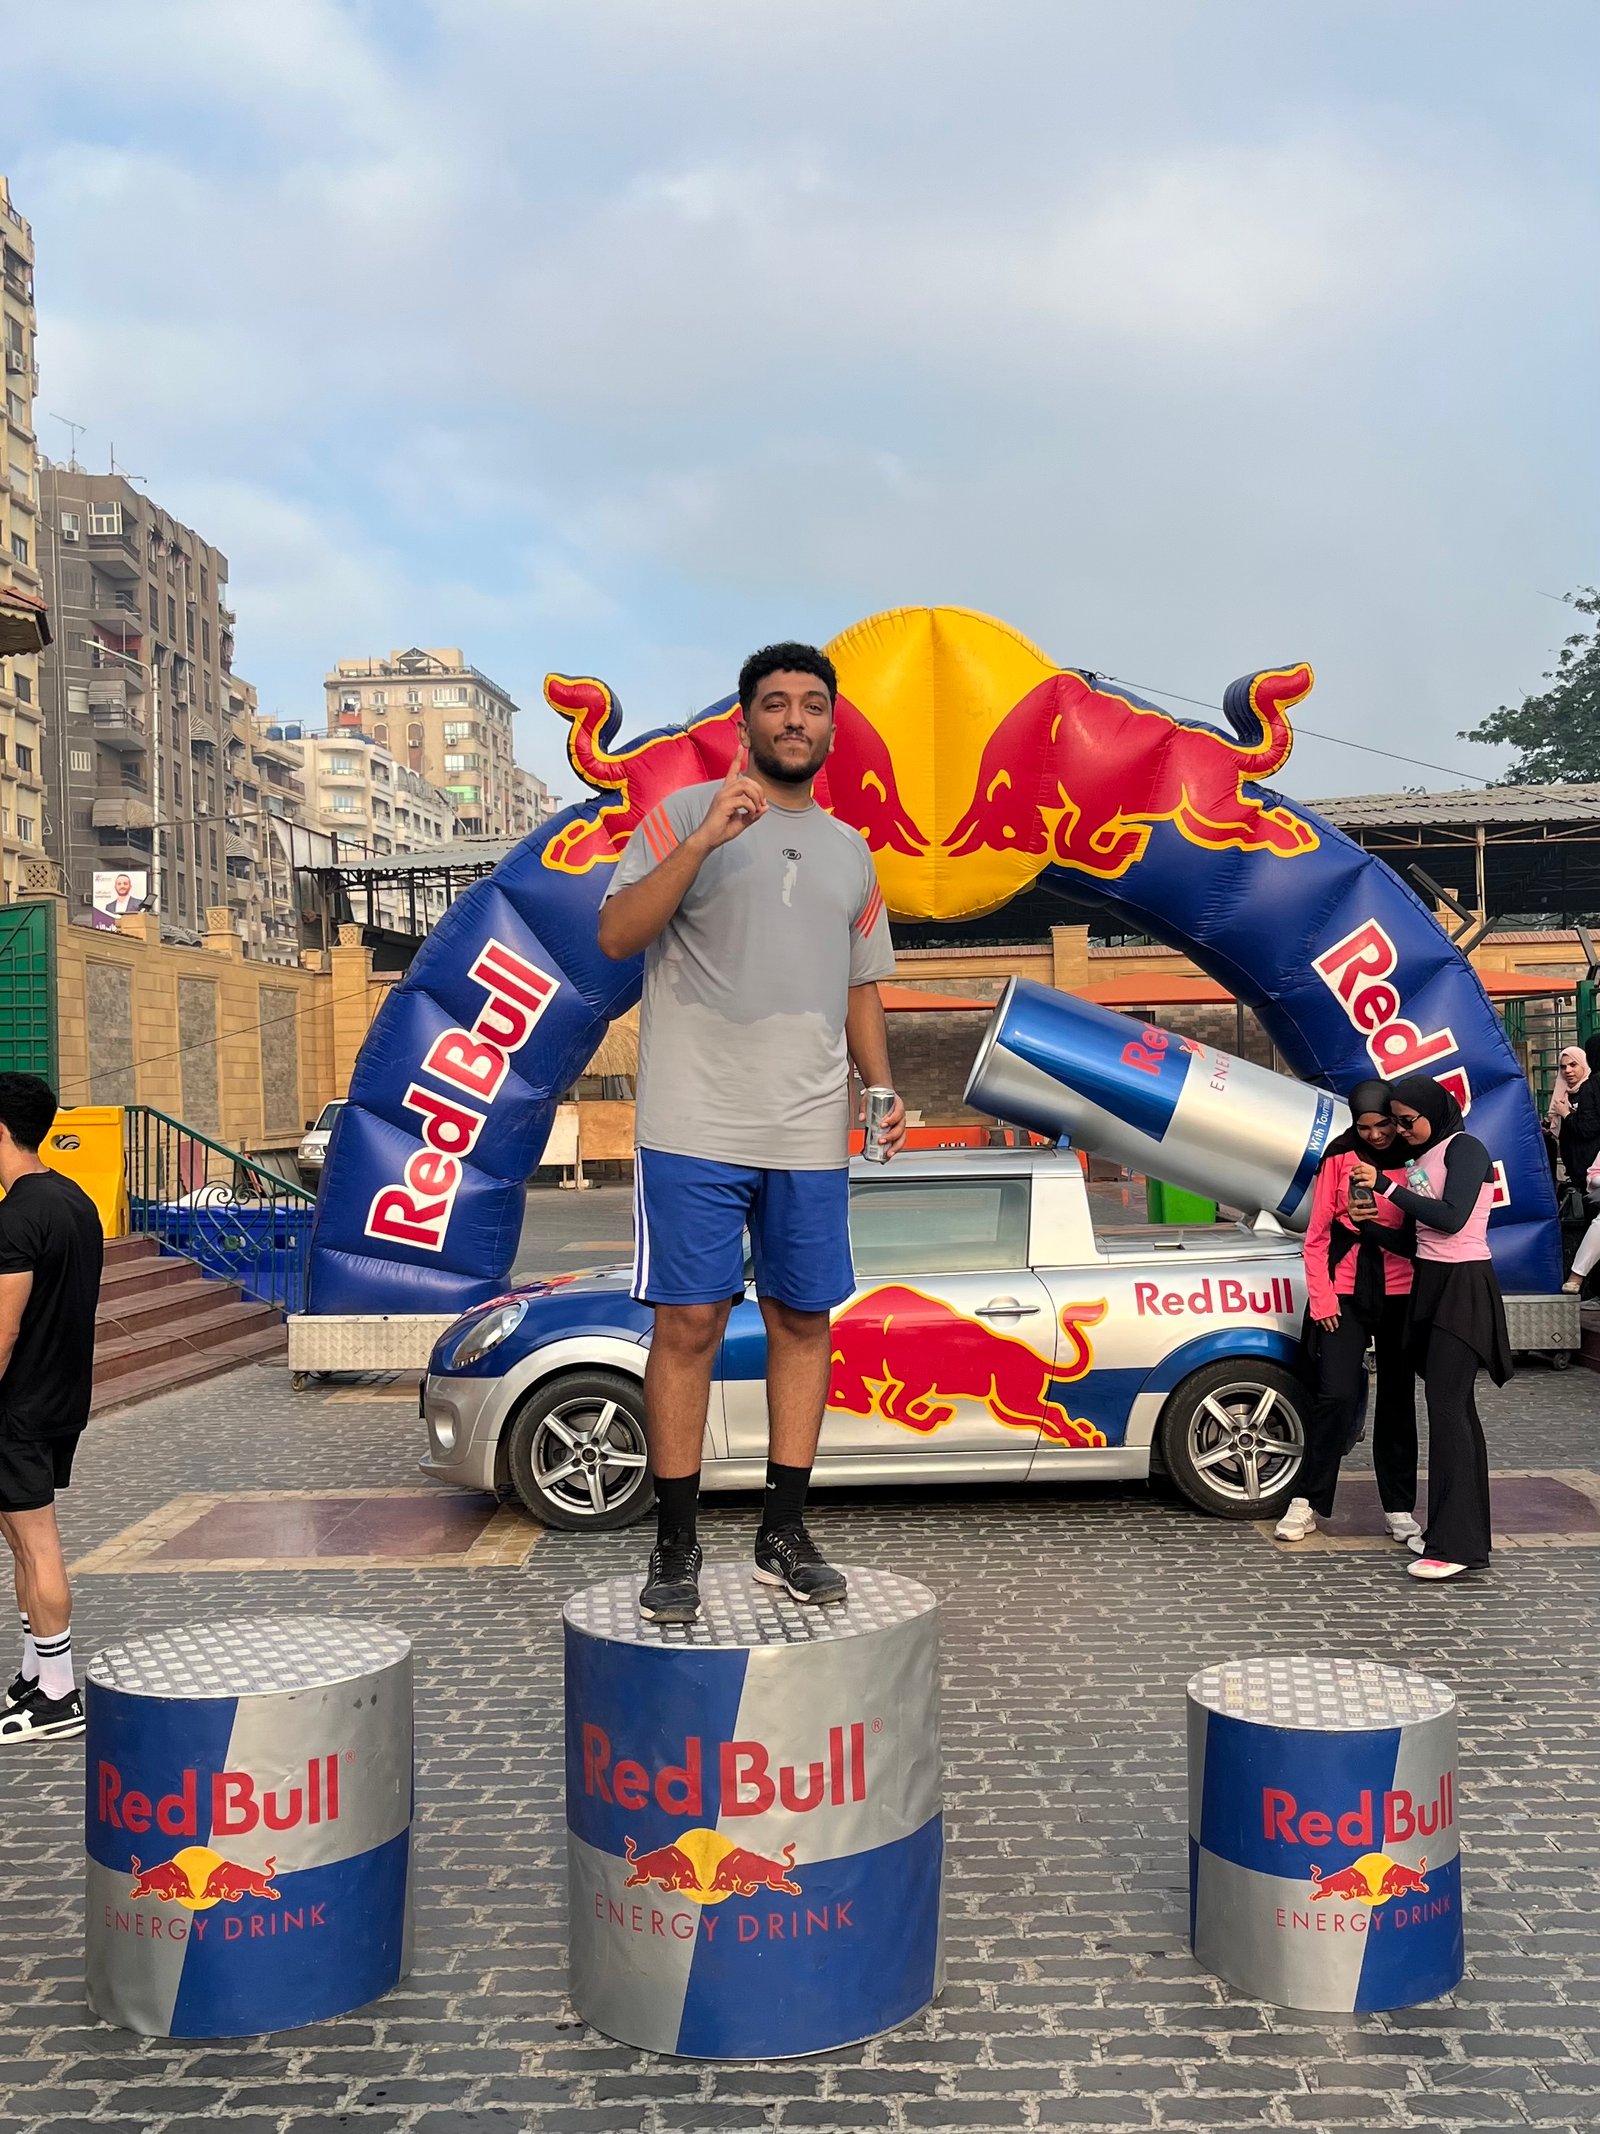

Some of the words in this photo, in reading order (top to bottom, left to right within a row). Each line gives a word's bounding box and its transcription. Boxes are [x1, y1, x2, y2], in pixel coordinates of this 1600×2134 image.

[1318, 924, 1453, 1076] Red
[369, 1089, 480, 1247] Red
[427, 944, 554, 1097] Bull
[1315, 1098, 1332, 1127] Taurine
[1307, 1123, 1325, 1151] With
[1134, 1278, 1214, 1316] Red
[1218, 1277, 1294, 1314] Bull
[583, 1722, 703, 1817] Red
[720, 1722, 866, 1817] Bull
[98, 1759, 198, 1836] Red
[212, 1753, 339, 1836] Bull
[1262, 1787, 1374, 1846] Red
[1383, 1770, 1454, 1844] Bull
[105, 1904, 208, 1941] ENERGY
[224, 1902, 326, 1940] DRINK
[595, 1893, 719, 1942] ENERGY
[738, 1901, 854, 1942] DRINK
[1275, 1908, 1385, 1932] ENERGY
[1395, 1897, 1450, 1928] DRINK
